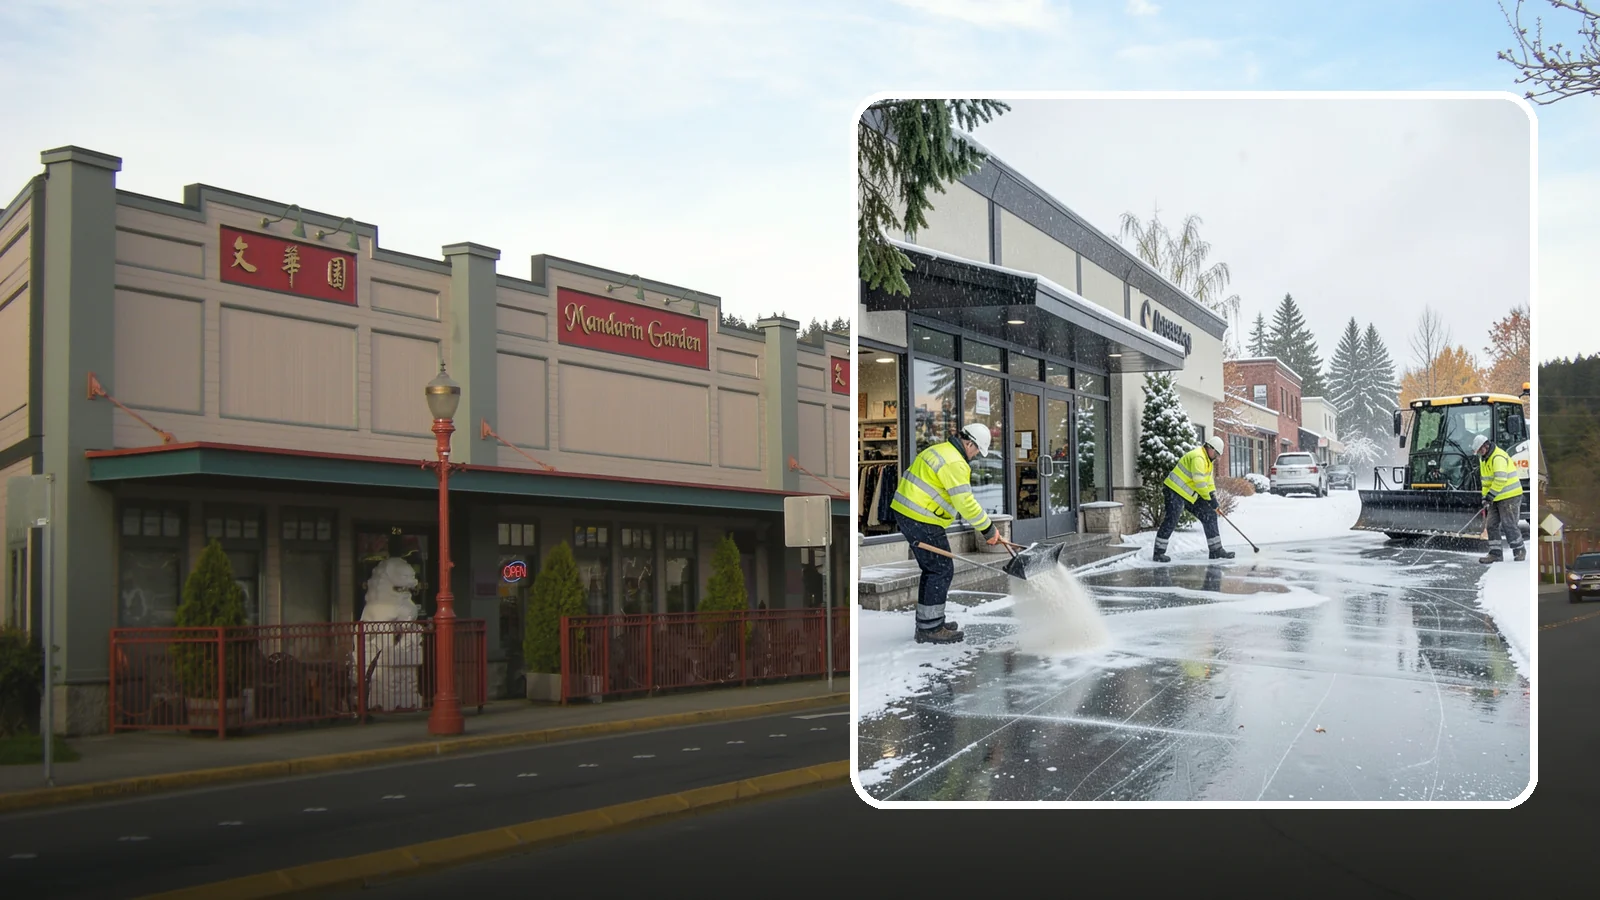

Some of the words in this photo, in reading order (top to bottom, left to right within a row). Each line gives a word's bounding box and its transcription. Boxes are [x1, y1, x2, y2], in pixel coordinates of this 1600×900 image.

[565, 302, 644, 340] Mandarin
[648, 320, 701, 352] Garden
[503, 565, 527, 578] OPEN
